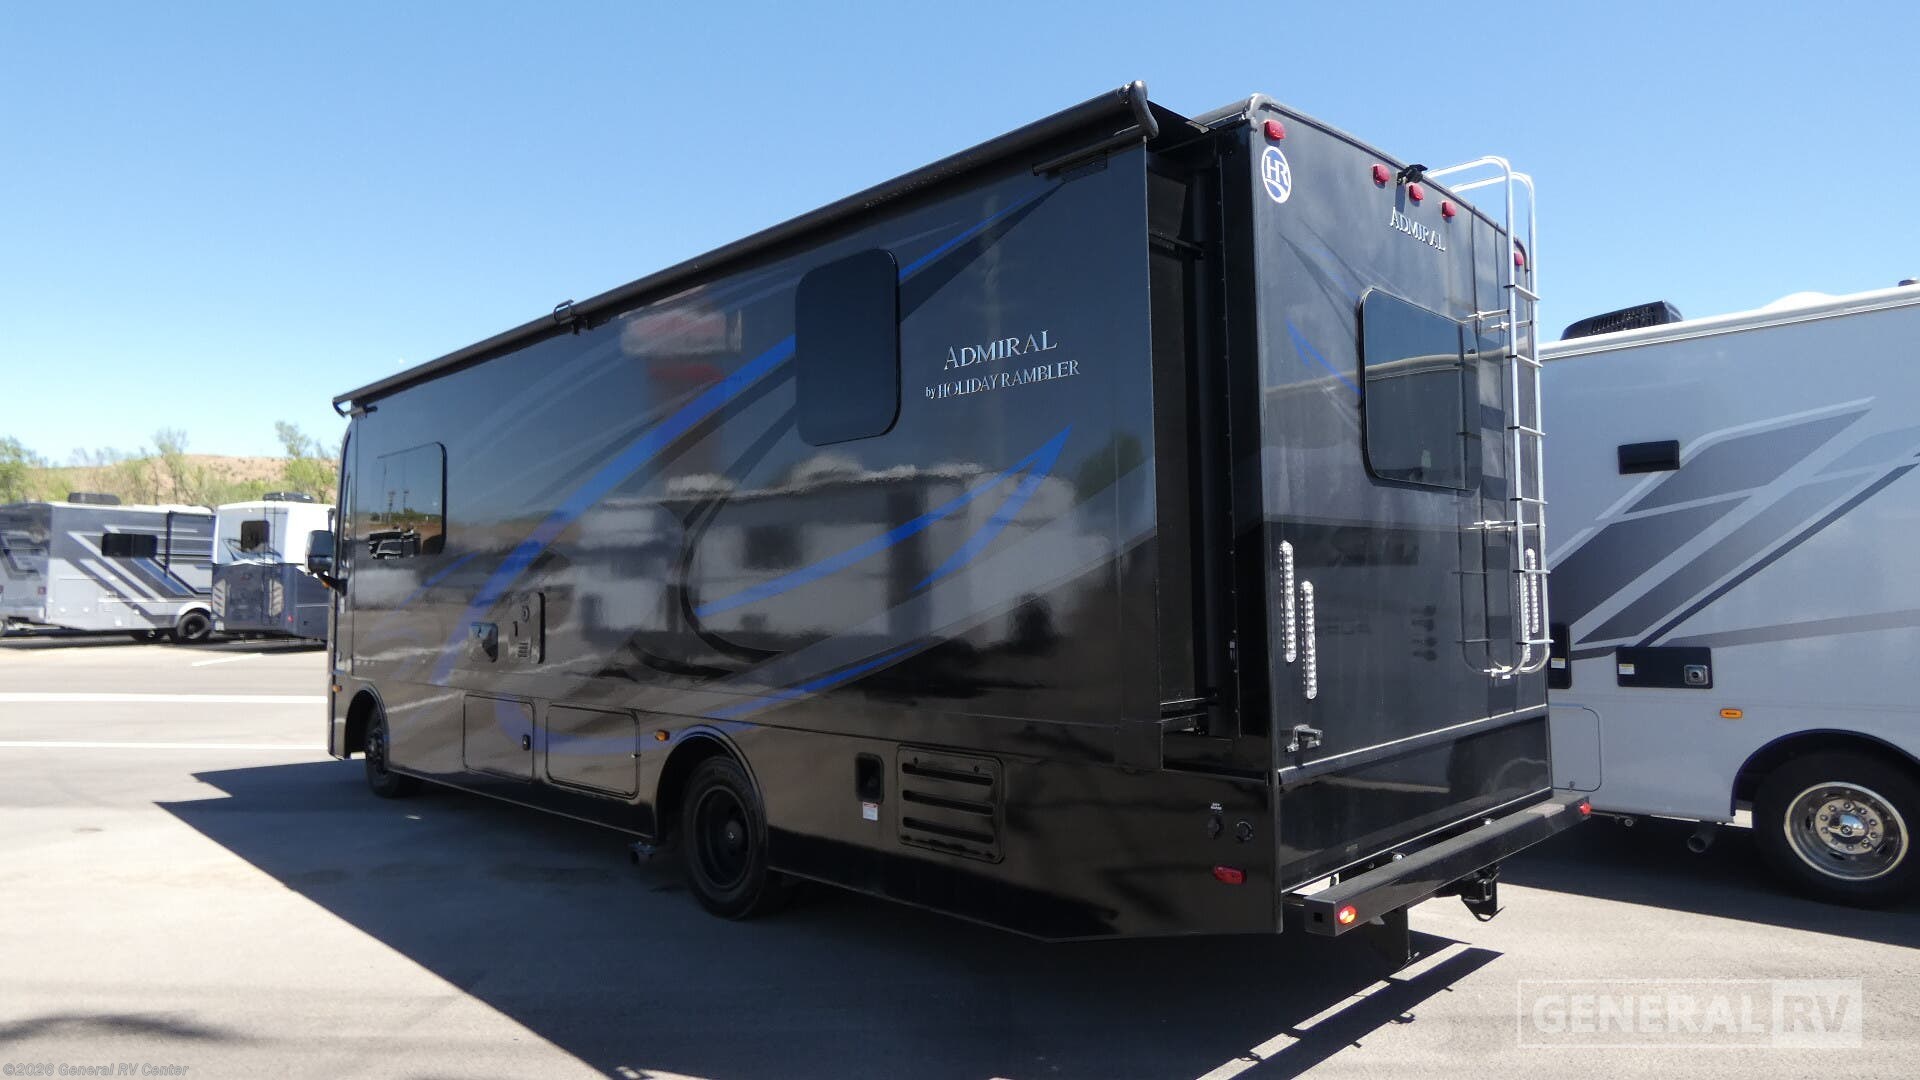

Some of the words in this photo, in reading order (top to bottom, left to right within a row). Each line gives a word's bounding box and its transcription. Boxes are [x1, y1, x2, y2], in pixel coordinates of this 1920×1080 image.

[1389, 206, 1447, 252] ADMIRAL
[943, 329, 1058, 371] ADMIRAL
[925, 386, 936, 400] by
[937, 373, 1000, 399] HOLIDAY
[1001, 359, 1081, 388] RAMBLER
